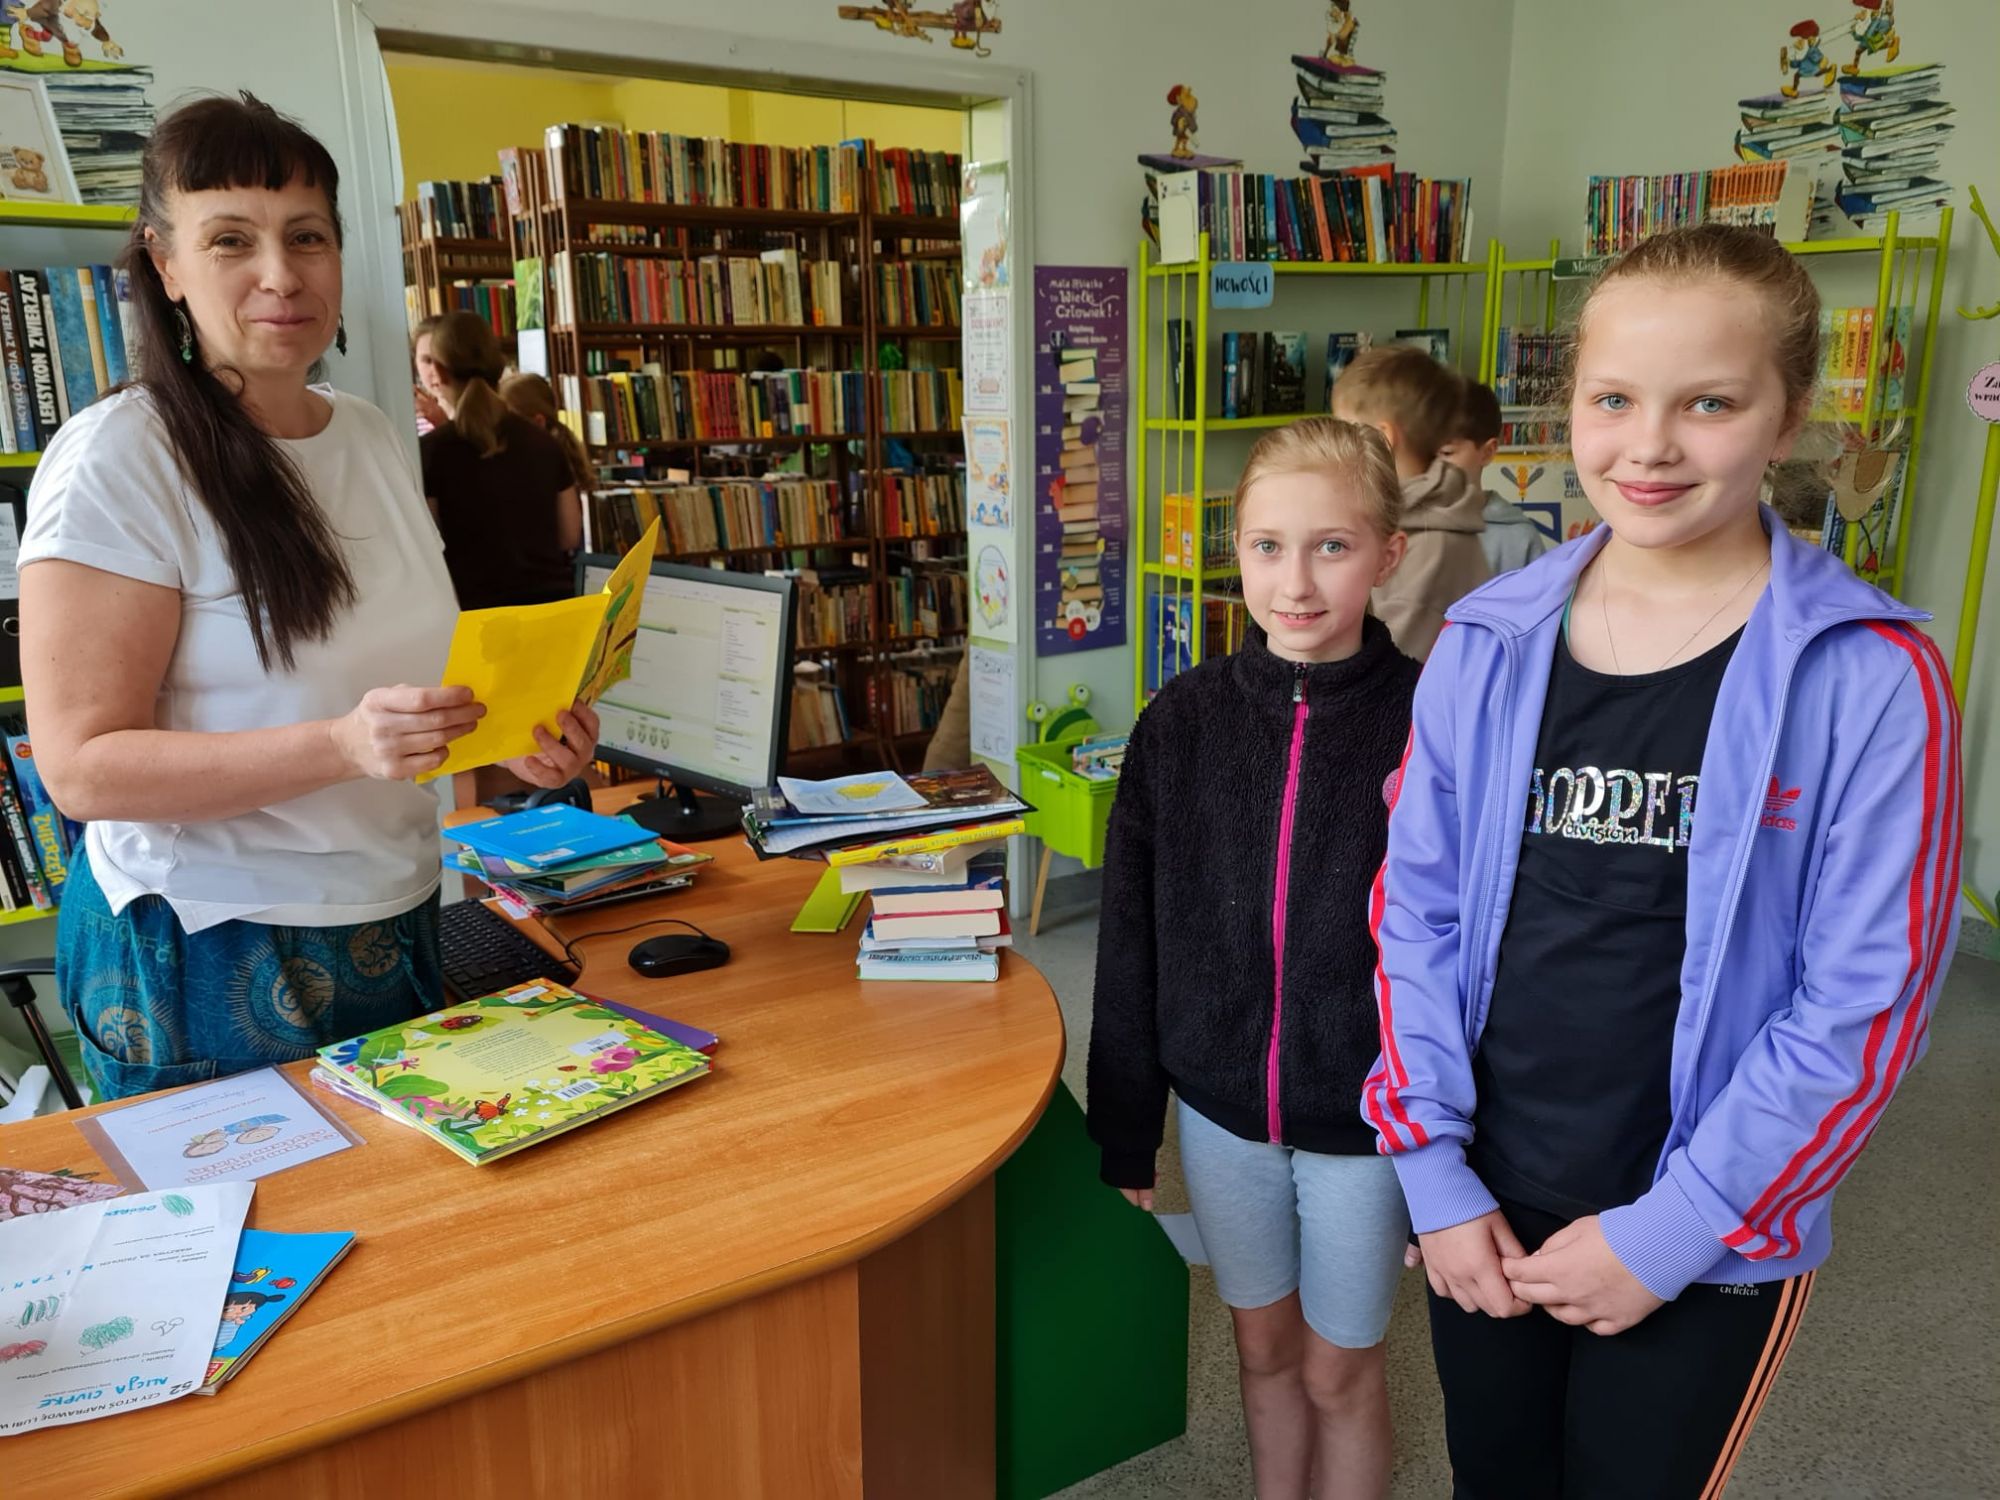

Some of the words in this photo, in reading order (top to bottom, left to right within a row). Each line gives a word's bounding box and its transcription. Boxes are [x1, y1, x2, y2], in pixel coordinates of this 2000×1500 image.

[1215, 270, 1269, 296] NOWOŚCI
[8, 350, 29, 431] ENCYKLOPEDIA
[31, 352, 56, 425] LEKSYKON
[1563, 817, 1640, 845] division
[115, 1376, 169, 1395] ALICJA
[141, 1391, 161, 1402] CZY
[169, 1380, 193, 1396] 52
